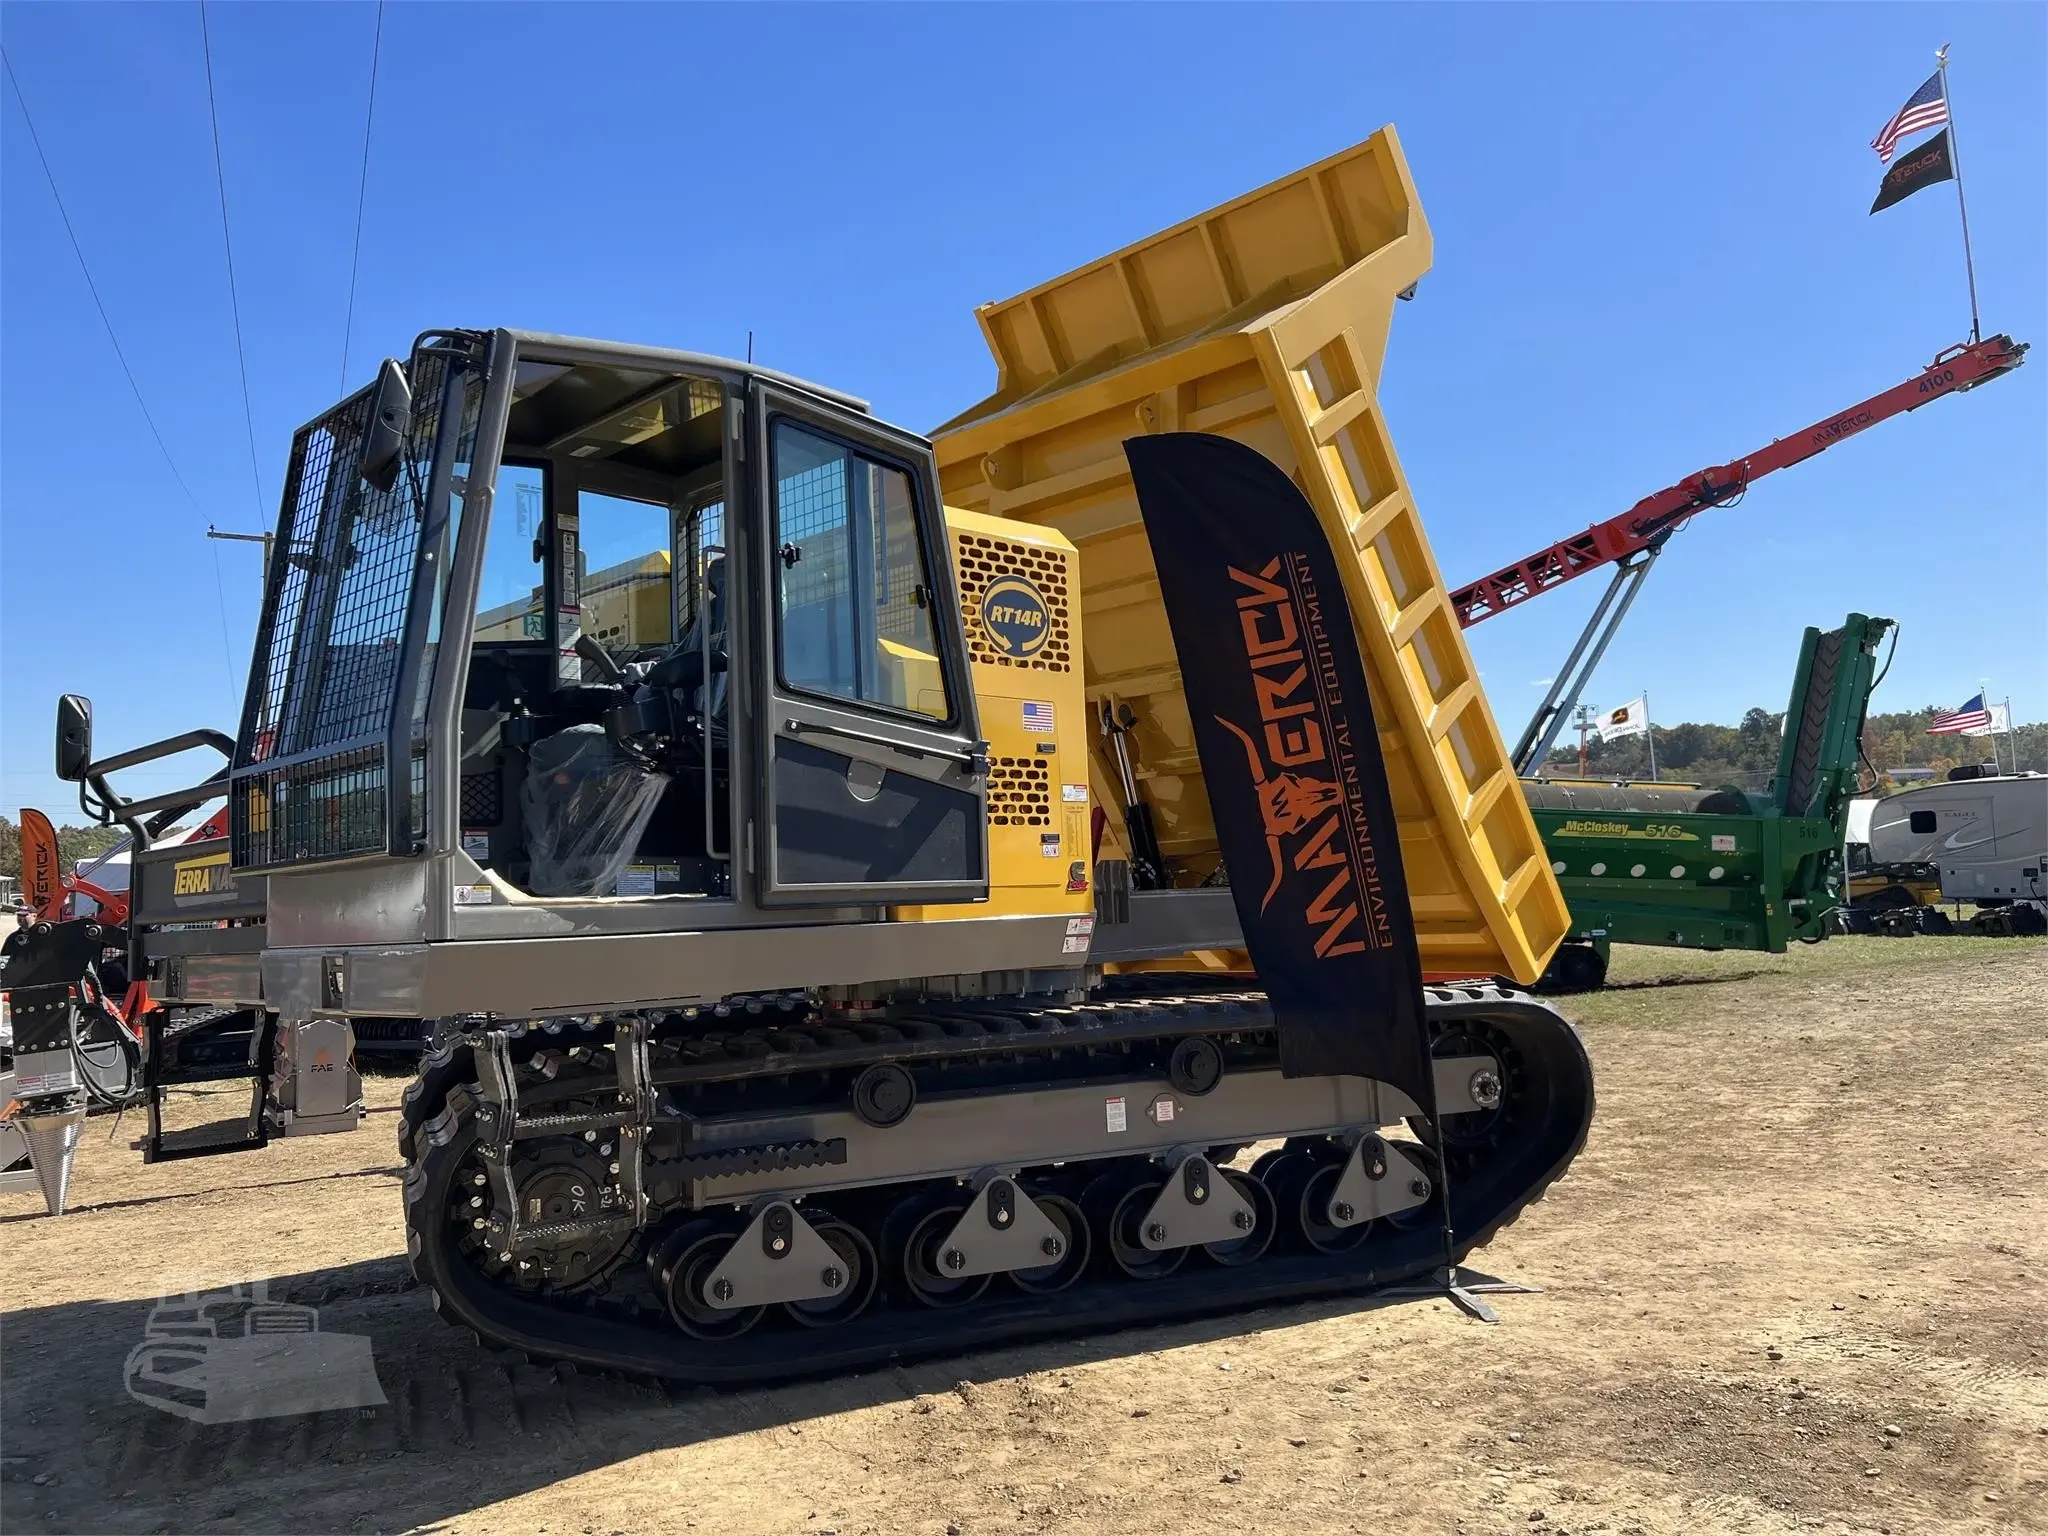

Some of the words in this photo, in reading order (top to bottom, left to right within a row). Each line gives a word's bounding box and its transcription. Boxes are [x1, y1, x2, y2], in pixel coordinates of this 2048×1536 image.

[1919, 370, 1954, 393] 4100
[990, 605, 1042, 628] RT14R
[1294, 551, 1344, 706] EQUIPMENT
[1333, 715, 1393, 948] ENVIRONMENTAL
[1566, 820, 1629, 836] McCloskey
[1645, 824, 1682, 838] 516
[311, 1063, 334, 1073] FAE
[571, 1185, 586, 1212] OK
